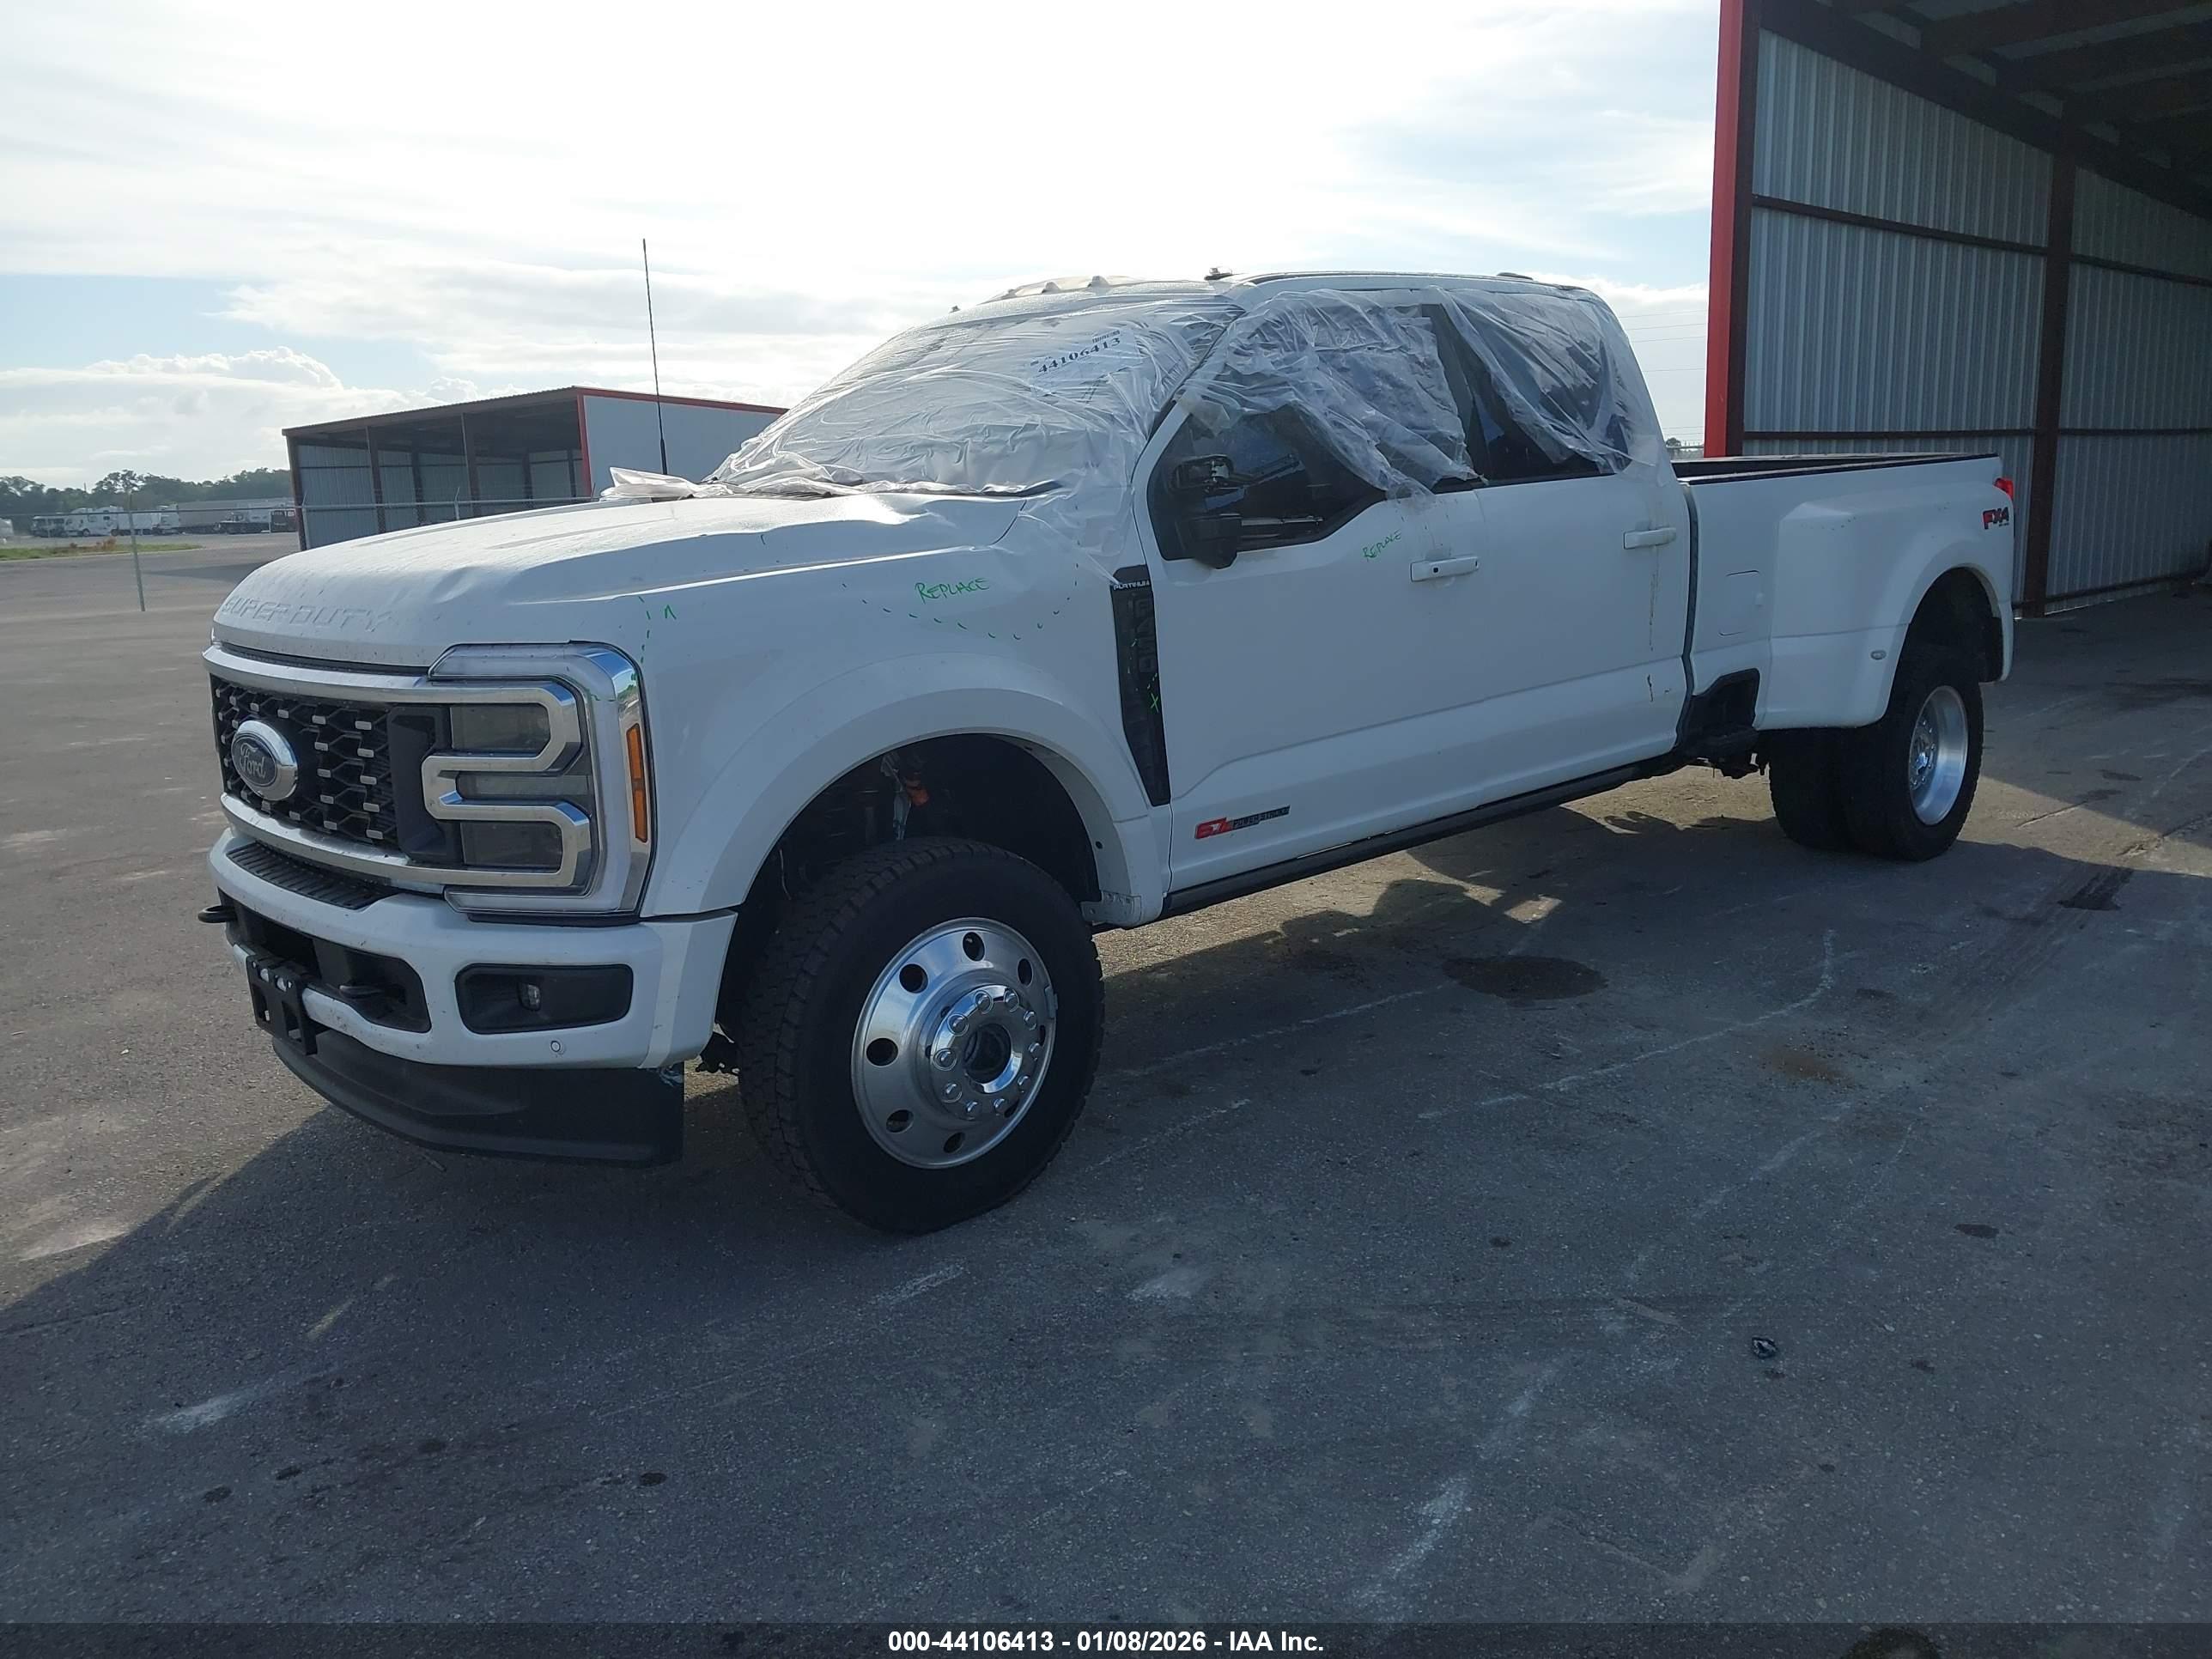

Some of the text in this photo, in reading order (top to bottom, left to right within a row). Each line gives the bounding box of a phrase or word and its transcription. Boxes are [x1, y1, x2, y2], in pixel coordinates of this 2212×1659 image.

[1037, 337, 1121, 373] 44106413
[1982, 507, 2009, 529] FX4
[915, 577, 990, 605] REPLACE
[1113, 580, 1151, 591] PLATINUM
[222, 595, 398, 633] SUPER DUTY
[240, 742, 267, 780] Ford
